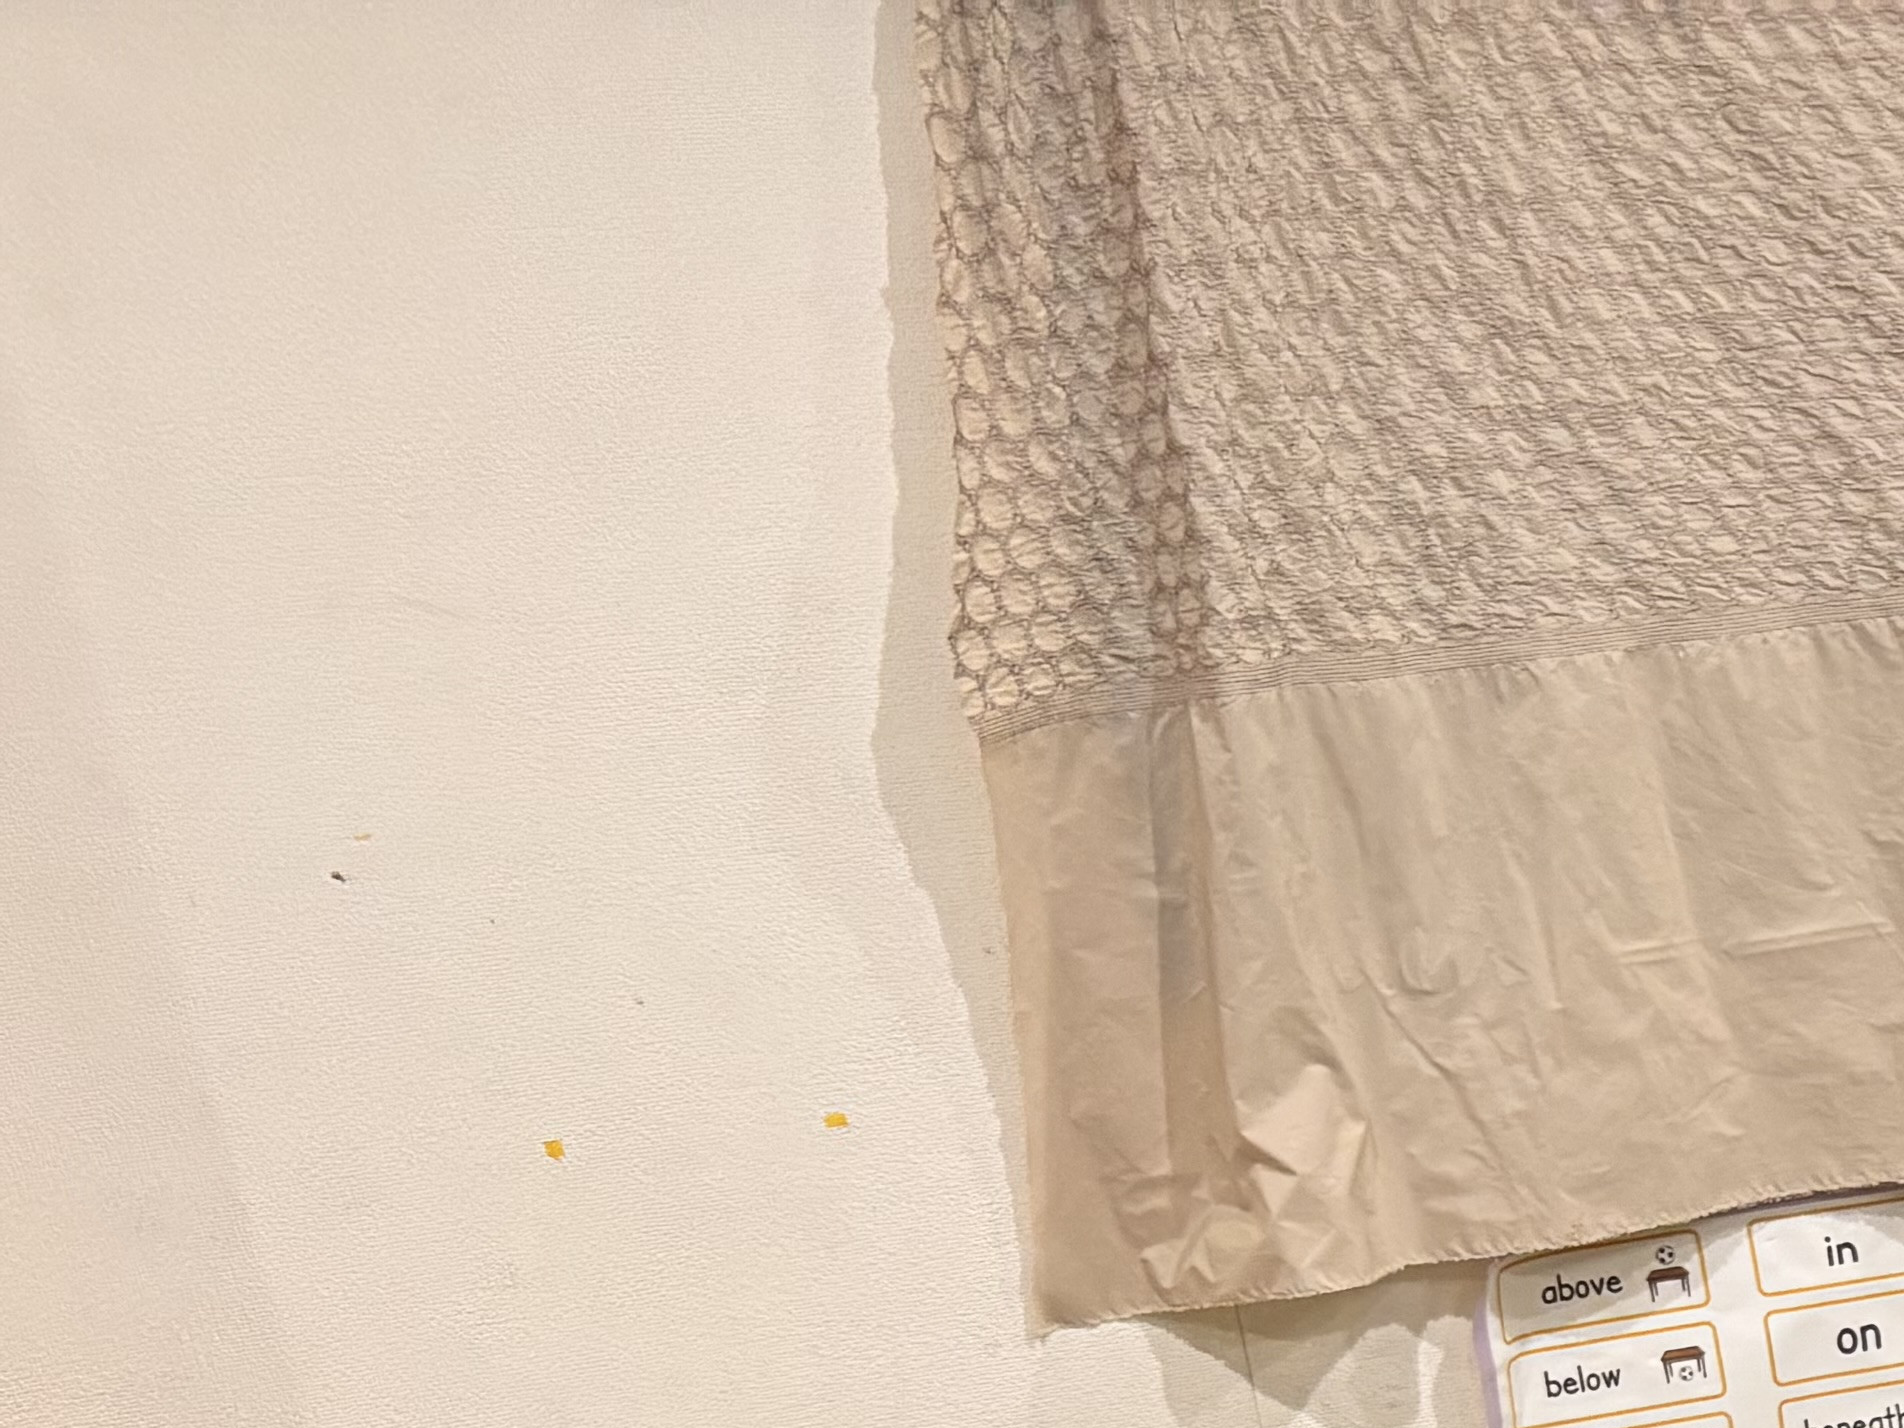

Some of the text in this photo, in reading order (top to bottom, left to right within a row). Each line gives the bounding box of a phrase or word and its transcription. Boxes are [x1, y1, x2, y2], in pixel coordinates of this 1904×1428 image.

[1824, 1233, 1860, 1267] in
[1540, 1271, 1624, 1305] above
[1836, 1322, 1883, 1355] on
[1543, 1363, 1623, 1399] below
